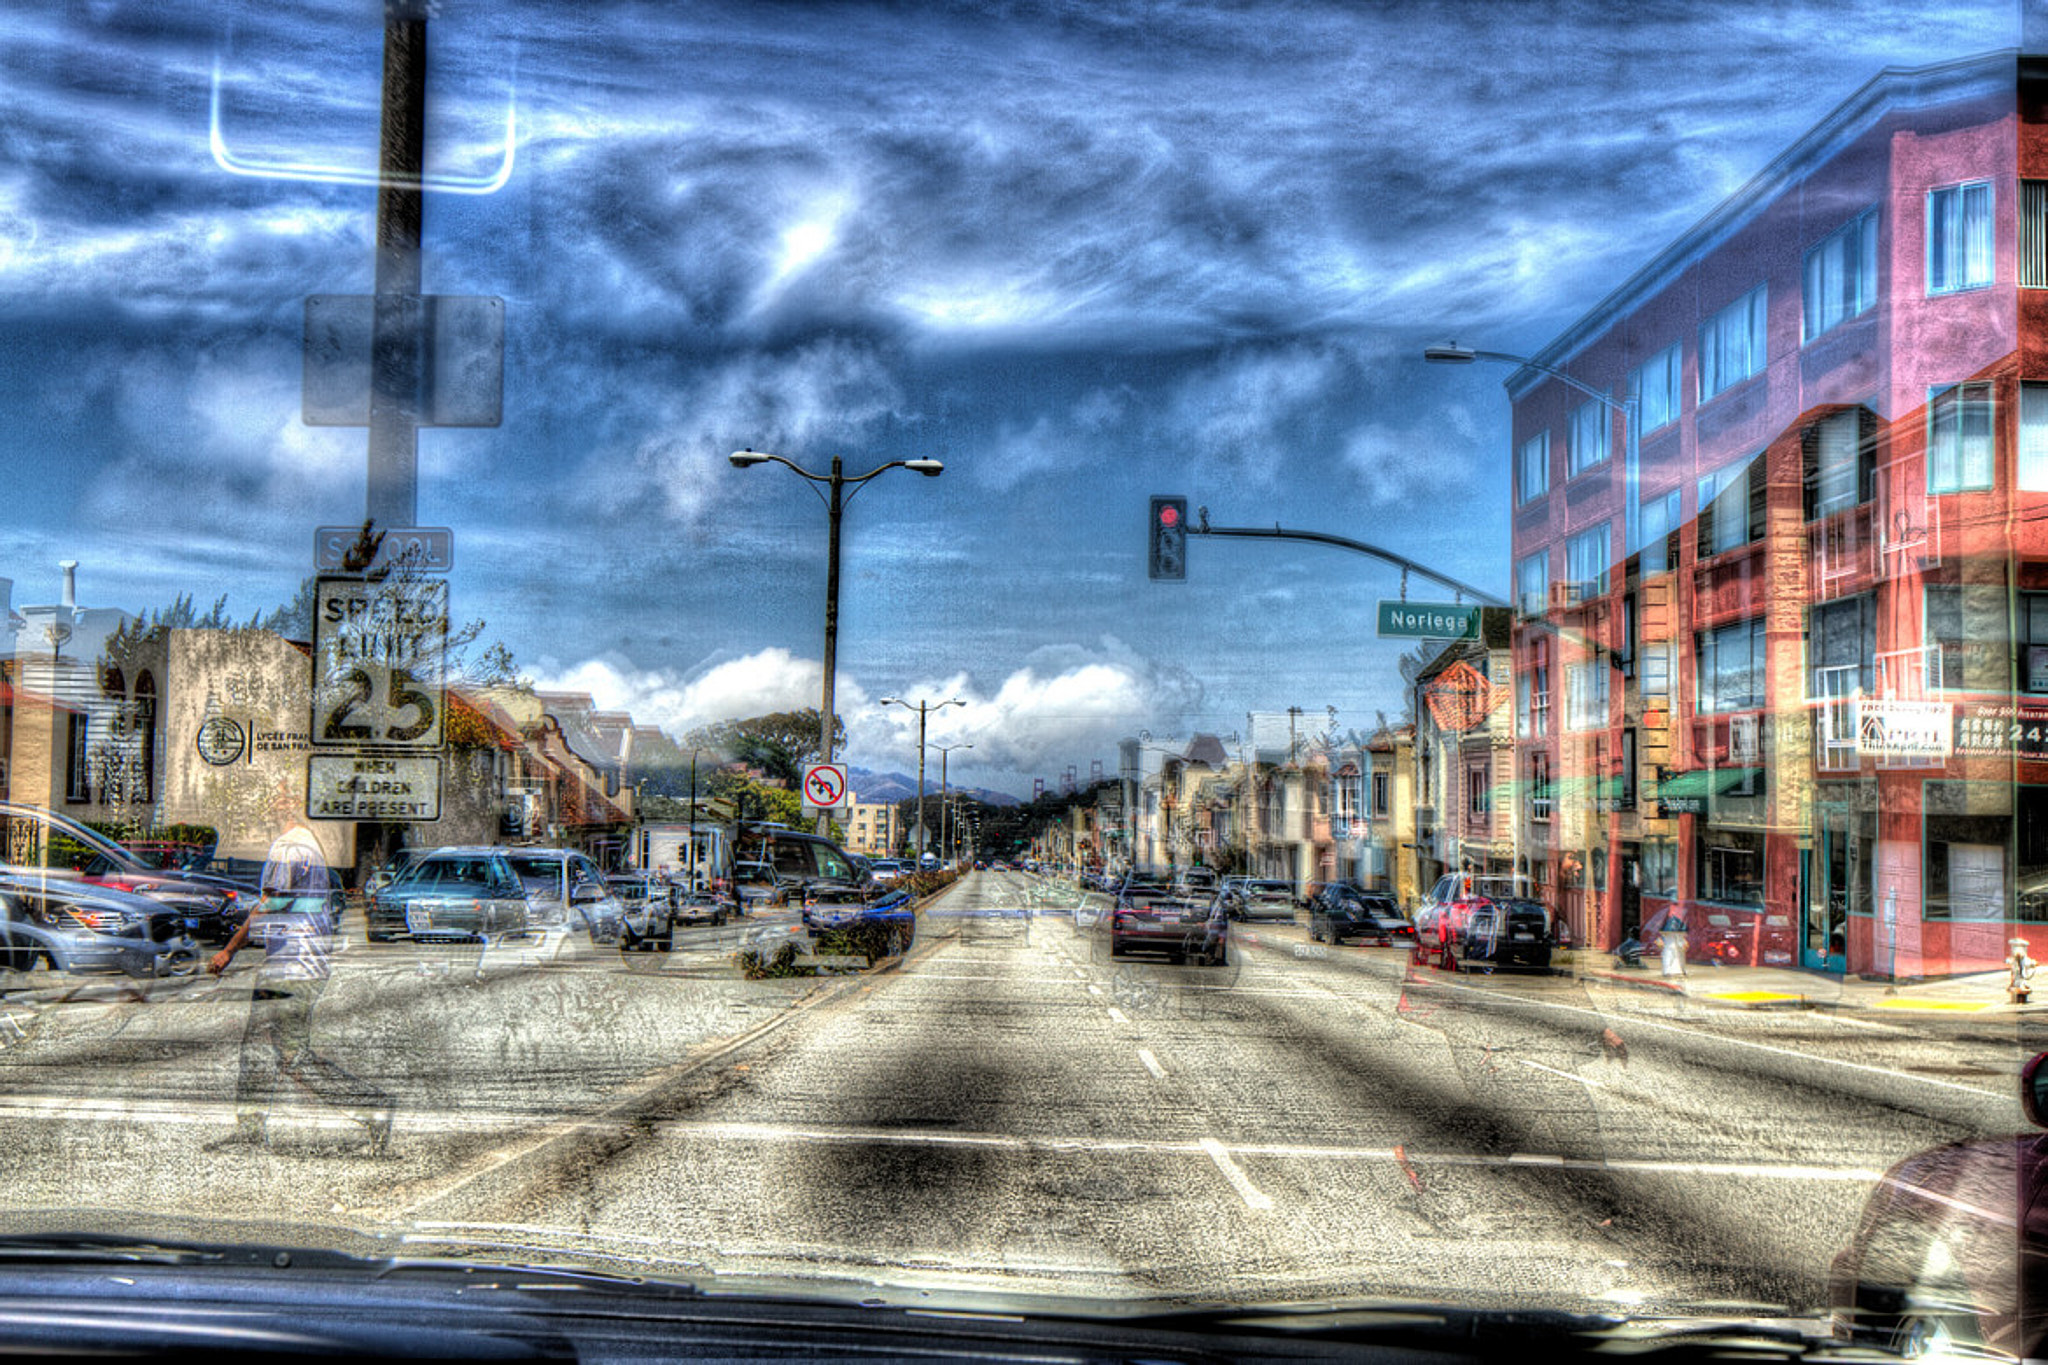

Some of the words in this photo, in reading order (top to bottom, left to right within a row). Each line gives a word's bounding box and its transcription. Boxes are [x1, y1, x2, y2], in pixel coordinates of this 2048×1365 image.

[1390, 610, 1468, 632] Noriega
[324, 668, 435, 741] 25
[256, 743, 269, 752] DE
[271, 743, 290, 752] SAN
[353, 761, 397, 774] WHEN
[320, 800, 352, 815] ARE
[357, 801, 428, 816] PRESENT
